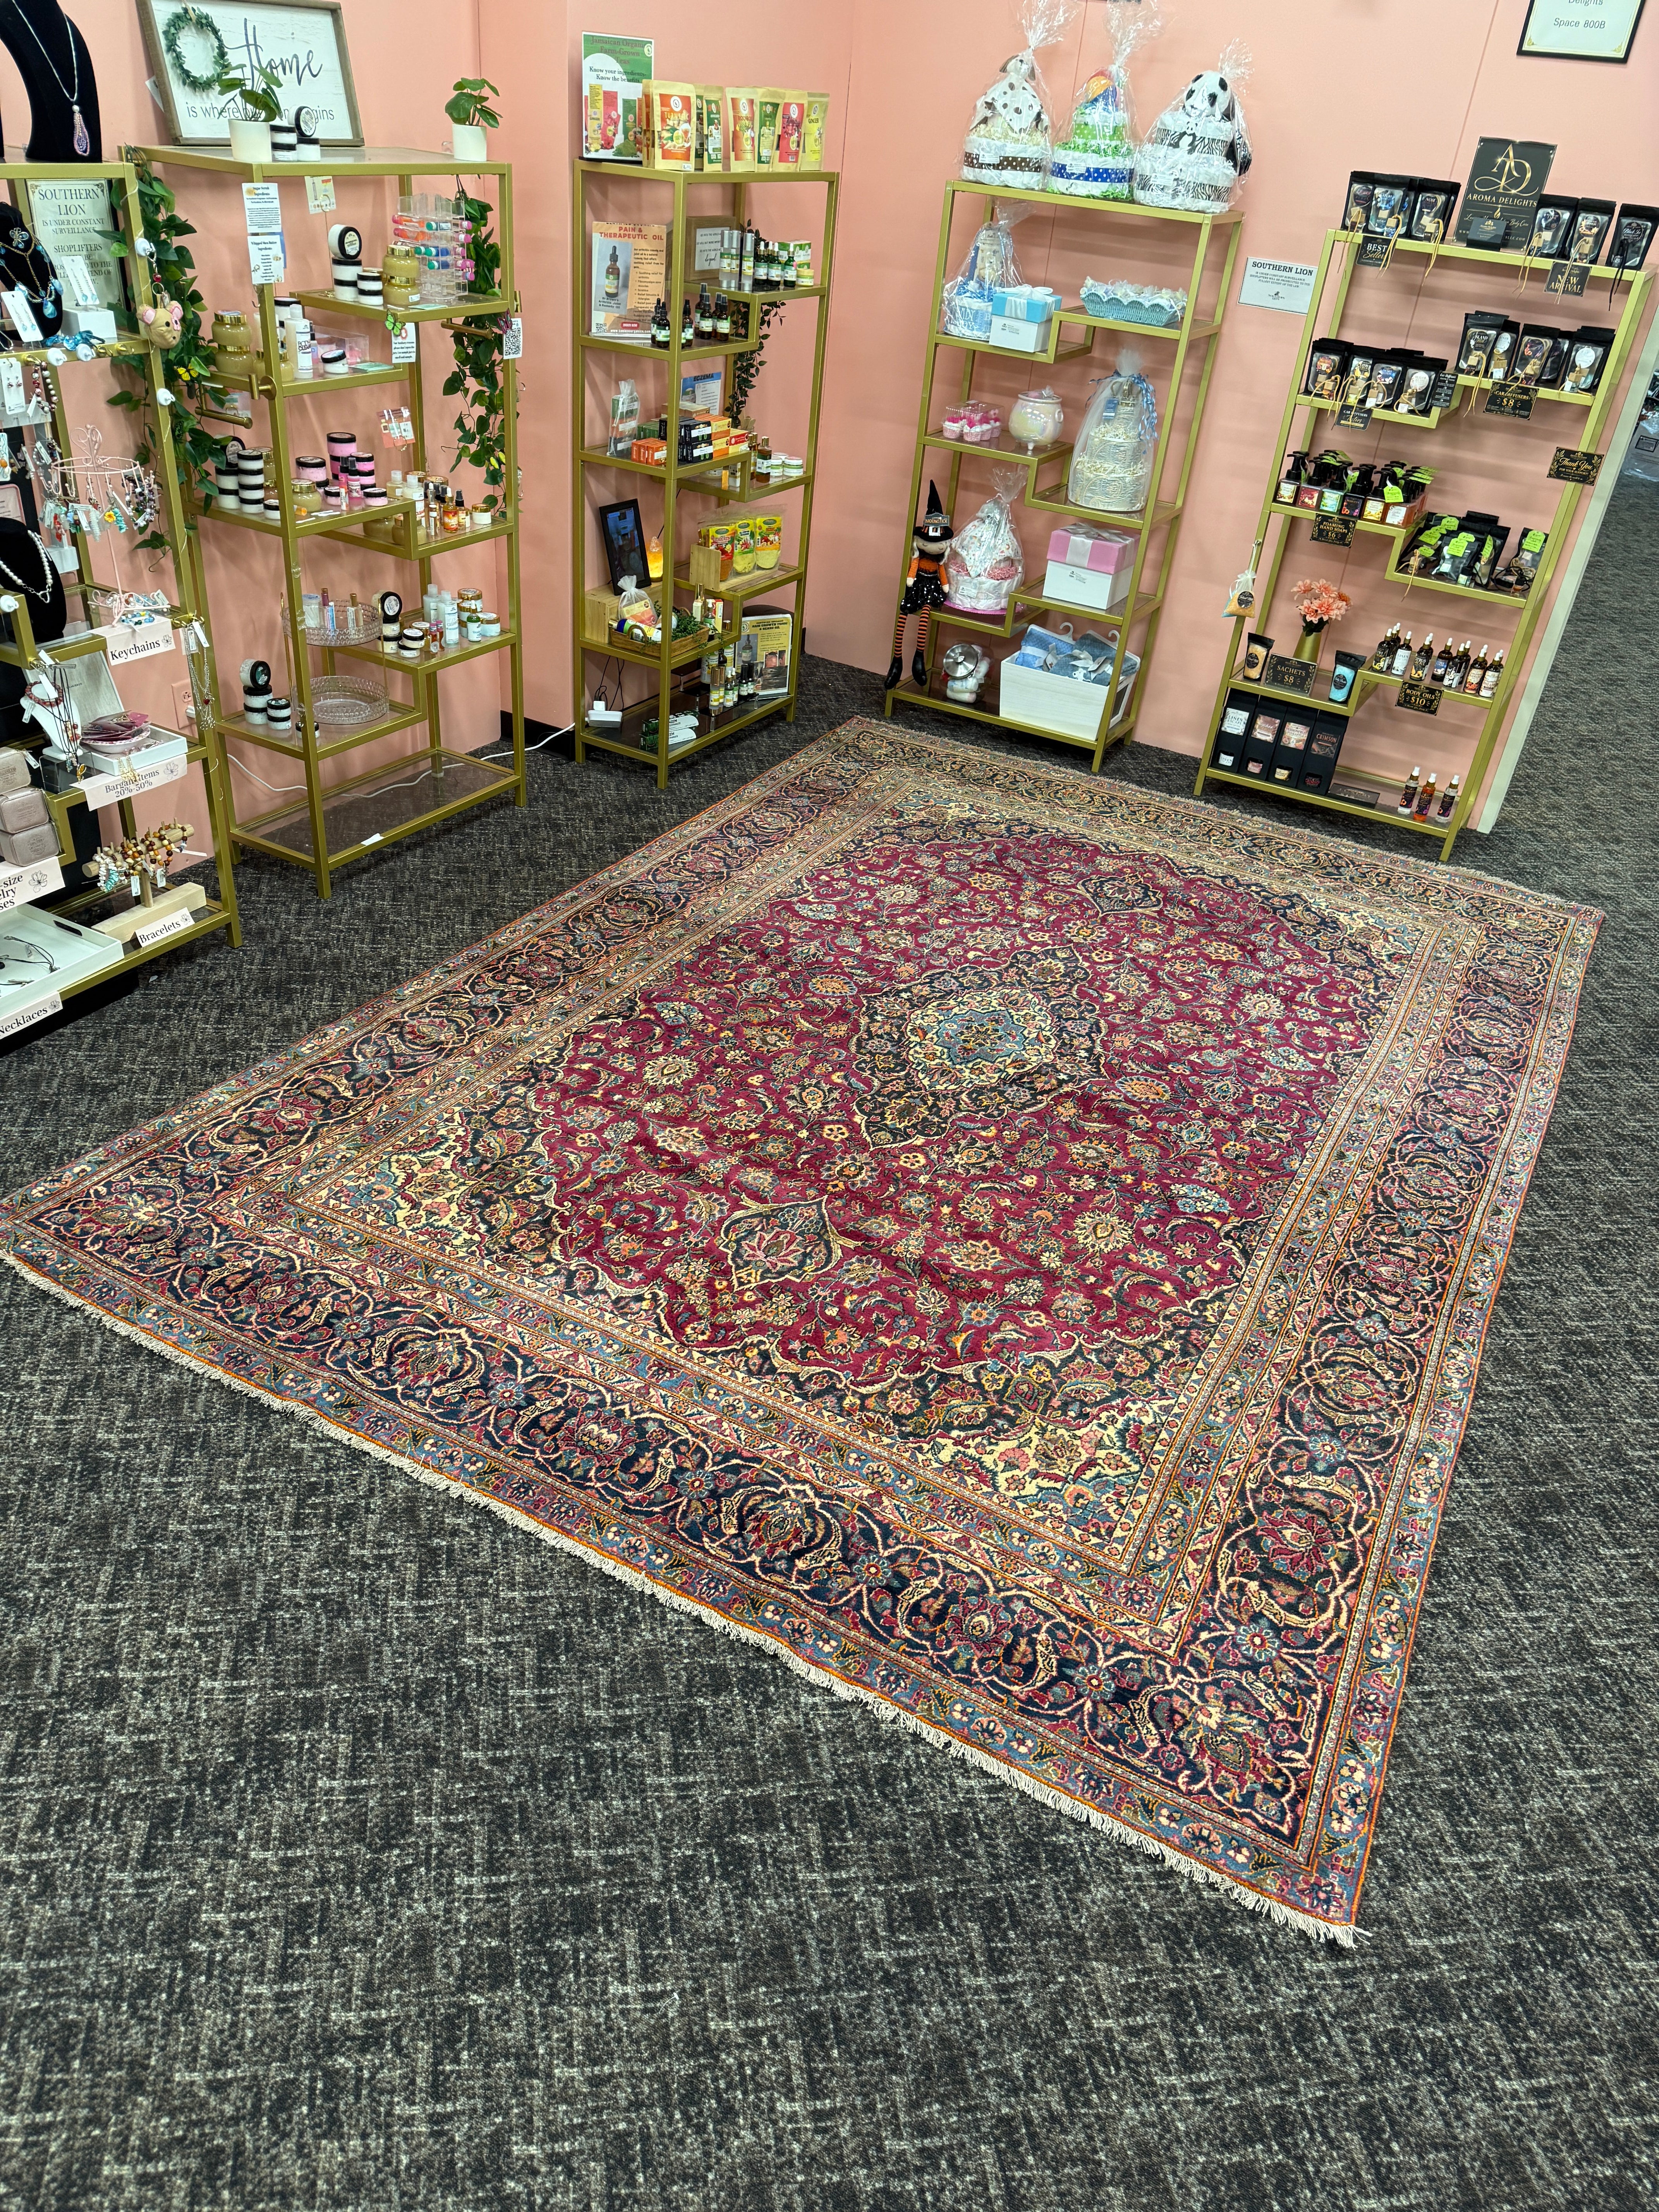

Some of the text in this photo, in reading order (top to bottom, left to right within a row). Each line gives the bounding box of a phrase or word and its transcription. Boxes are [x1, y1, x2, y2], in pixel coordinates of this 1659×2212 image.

[1554, 18, 1606, 29] Space 800B
[591, 36, 644, 49] Jamaican Organi
[223, 18, 323, 90] Home
[600, 46, 640, 56] Farm-Grown
[186, 102, 198, 118] is
[200, 103, 241, 118] where
[39, 189, 100, 200] SOUTHERN
[1467, 193, 1537, 207] AROMA DELIGHTS
[58, 204, 86, 215] LION
[1510, 218, 1519, 227] Body
[54, 244, 102, 252] SHOPLIFTERS
[1367, 243, 1388, 252] BEST
[1252, 261, 1313, 276] SOUTHERN LION
[1557, 275, 1579, 284] NEW
[694, 373, 714, 381] ECZEMA
[1502, 398, 1515, 407] $8
[1558, 457, 1593, 471] Thank You
[110, 640, 160, 660] Keychains
[1277, 665, 1306, 677] SACHETS
[1284, 675, 1294, 684] $8
[1410, 697, 1425, 706] $10
[1316, 733, 1338, 743] CRIMSON
[115, 779, 153, 798] 20%-50%
[139, 920, 181, 944] Bracelets
